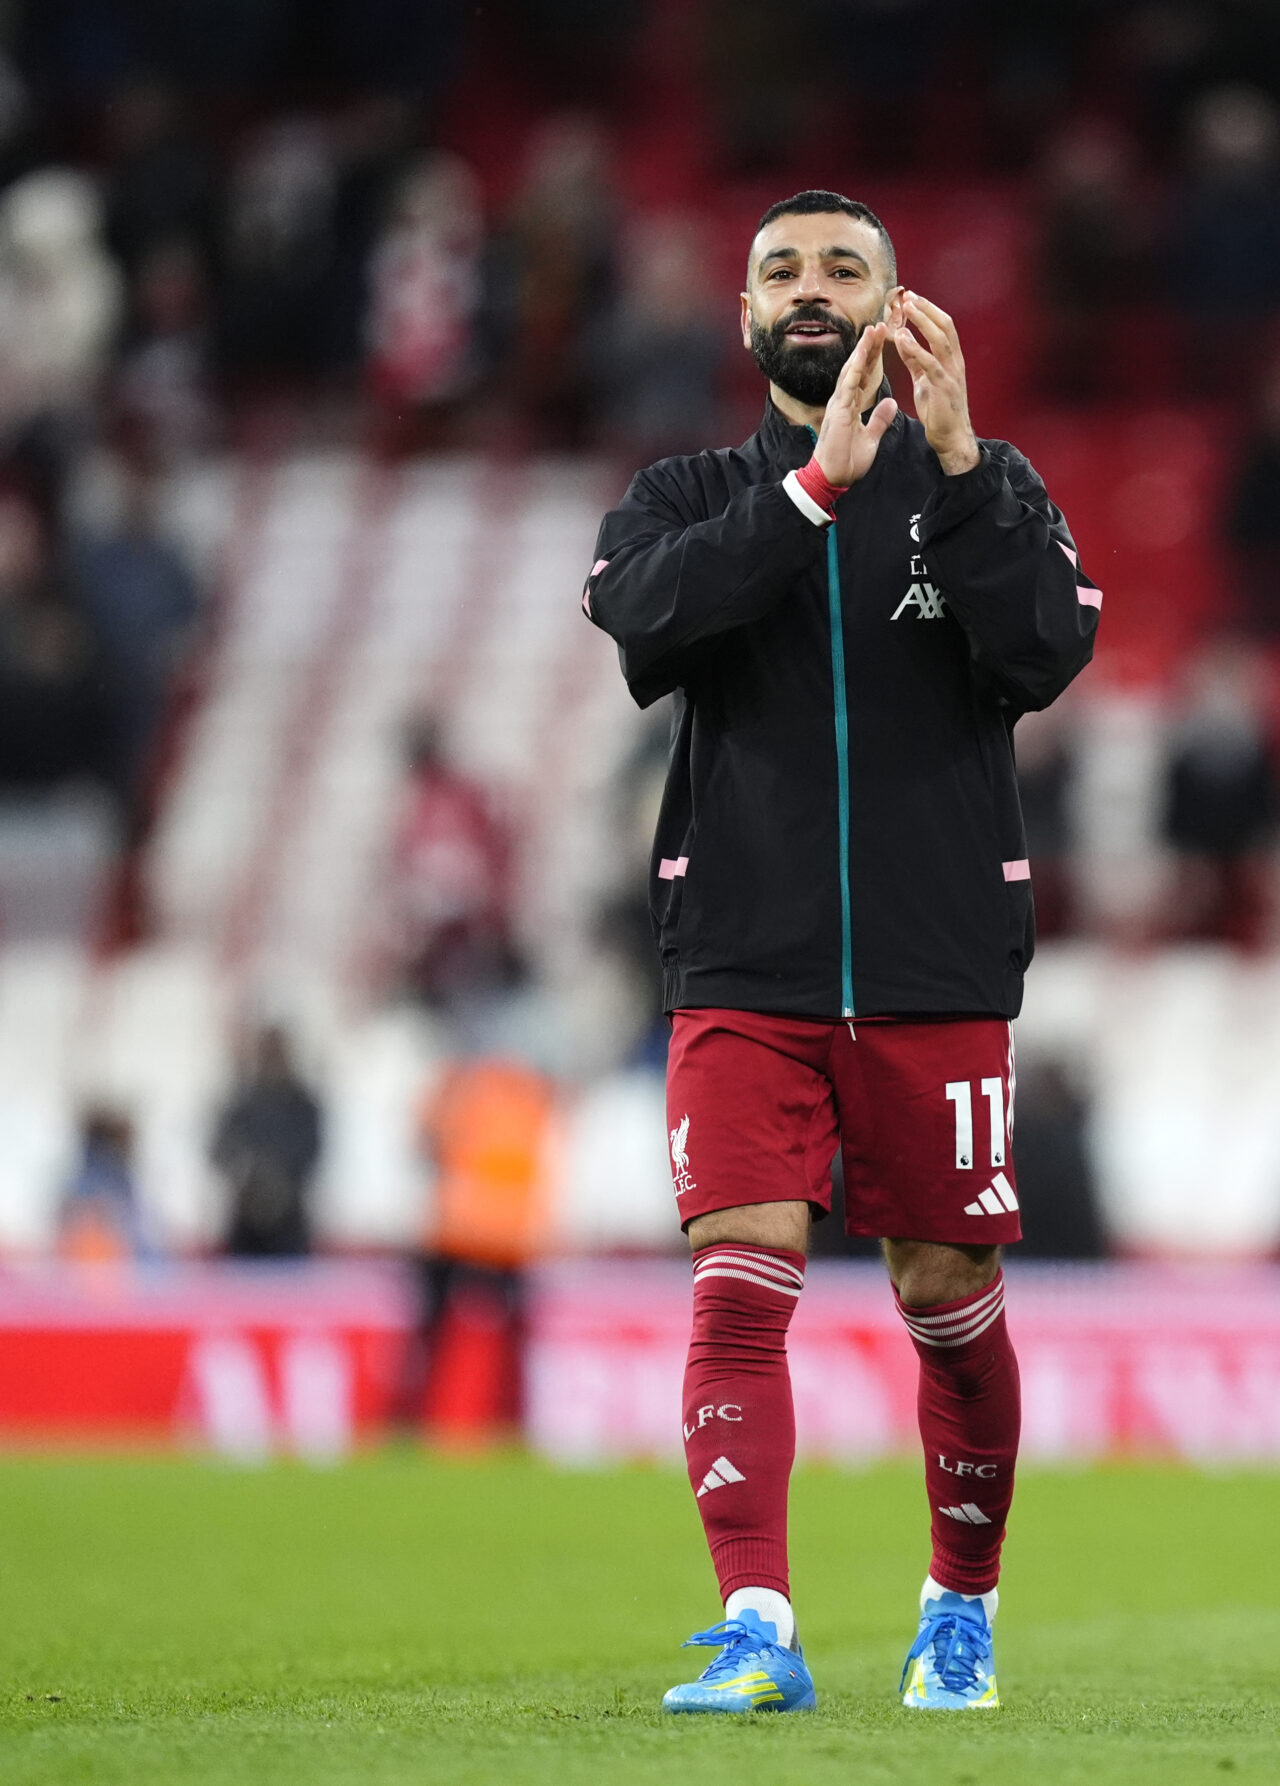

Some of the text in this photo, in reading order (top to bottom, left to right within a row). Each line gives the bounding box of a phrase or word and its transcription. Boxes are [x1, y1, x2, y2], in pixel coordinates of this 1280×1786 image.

[945, 1077, 1006, 1170] 11
[683, 1404, 743, 1442] LFC
[938, 1454, 998, 1479] LFC
